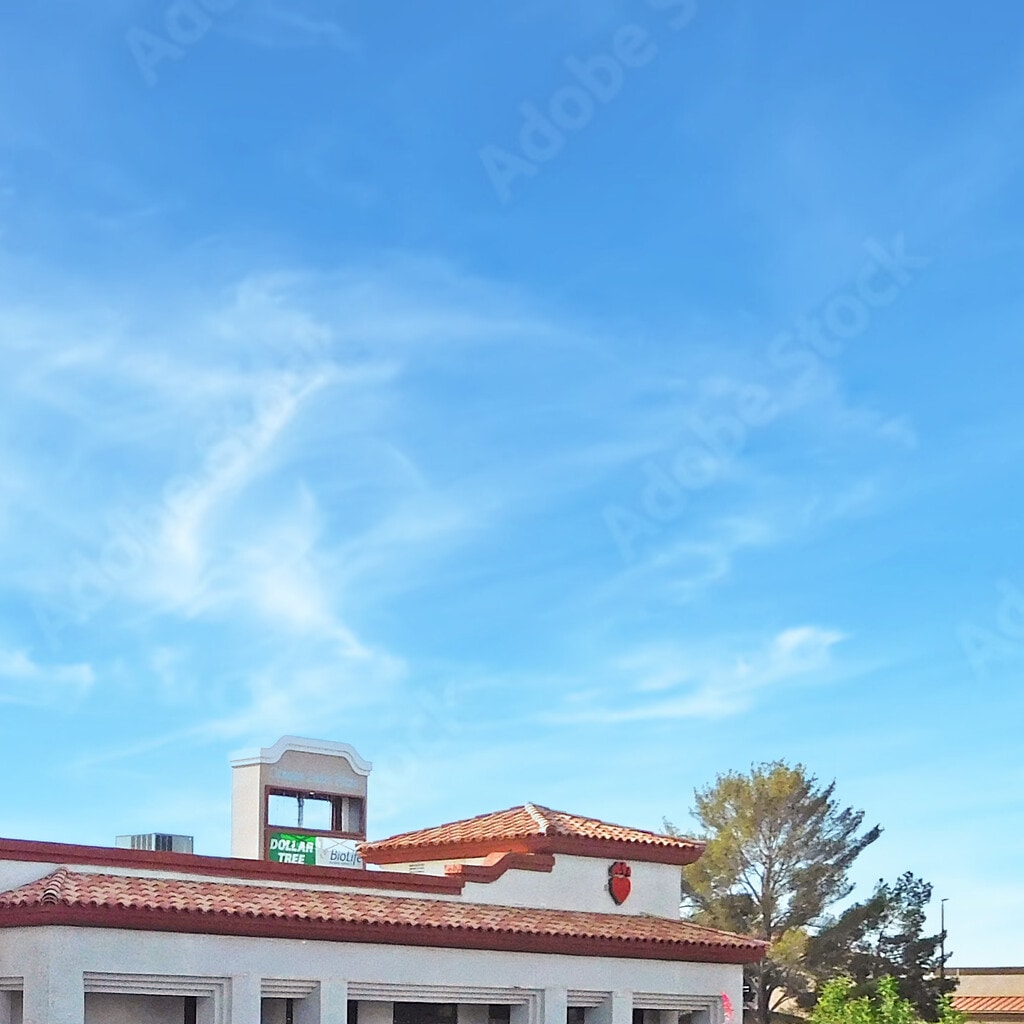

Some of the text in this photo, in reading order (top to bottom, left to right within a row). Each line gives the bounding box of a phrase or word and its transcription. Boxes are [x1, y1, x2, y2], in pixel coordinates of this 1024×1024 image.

[270, 838, 314, 853] DOLLAR
[277, 852, 305, 865] TREE
[330, 849, 362, 865] BioLife
